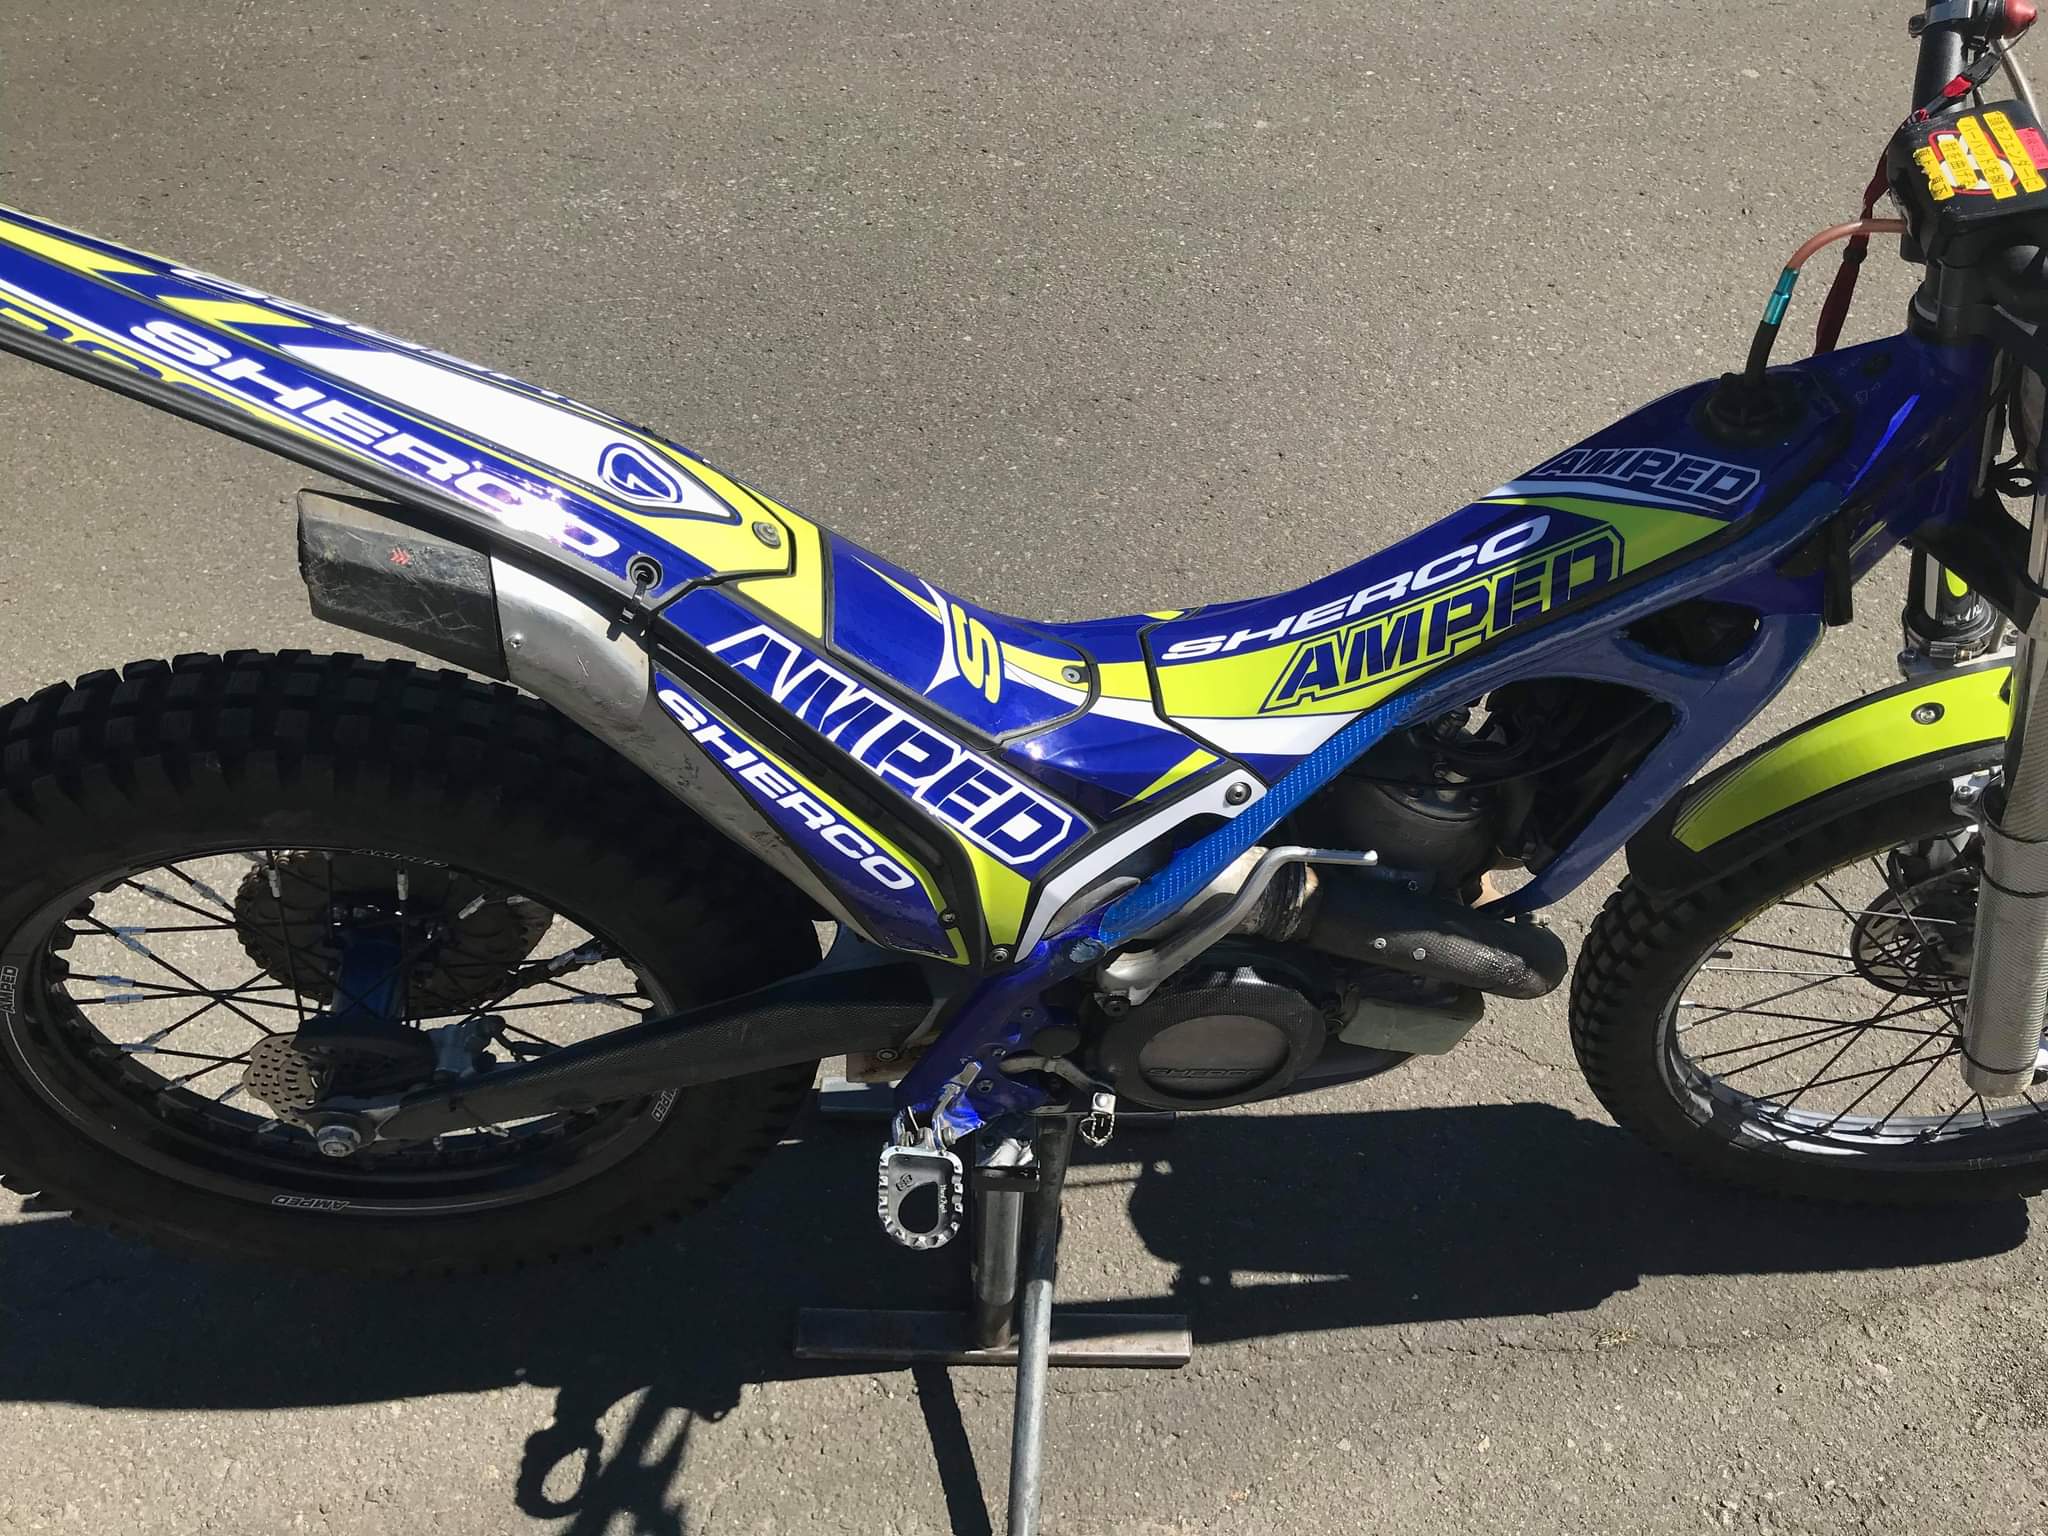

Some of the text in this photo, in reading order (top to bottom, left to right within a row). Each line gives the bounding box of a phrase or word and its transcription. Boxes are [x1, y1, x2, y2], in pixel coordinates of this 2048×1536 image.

[130, 320, 620, 558] SHERCO
[1532, 447, 1760, 504] AMPED
[1161, 514, 1551, 661] SHERCO
[1262, 527, 1625, 711] AMPED
[657, 688, 915, 890] SHERCO
[707, 624, 1073, 866] AMPED
[0, 965, 19, 1014] AMPED
[271, 1194, 351, 1211] AMPED
